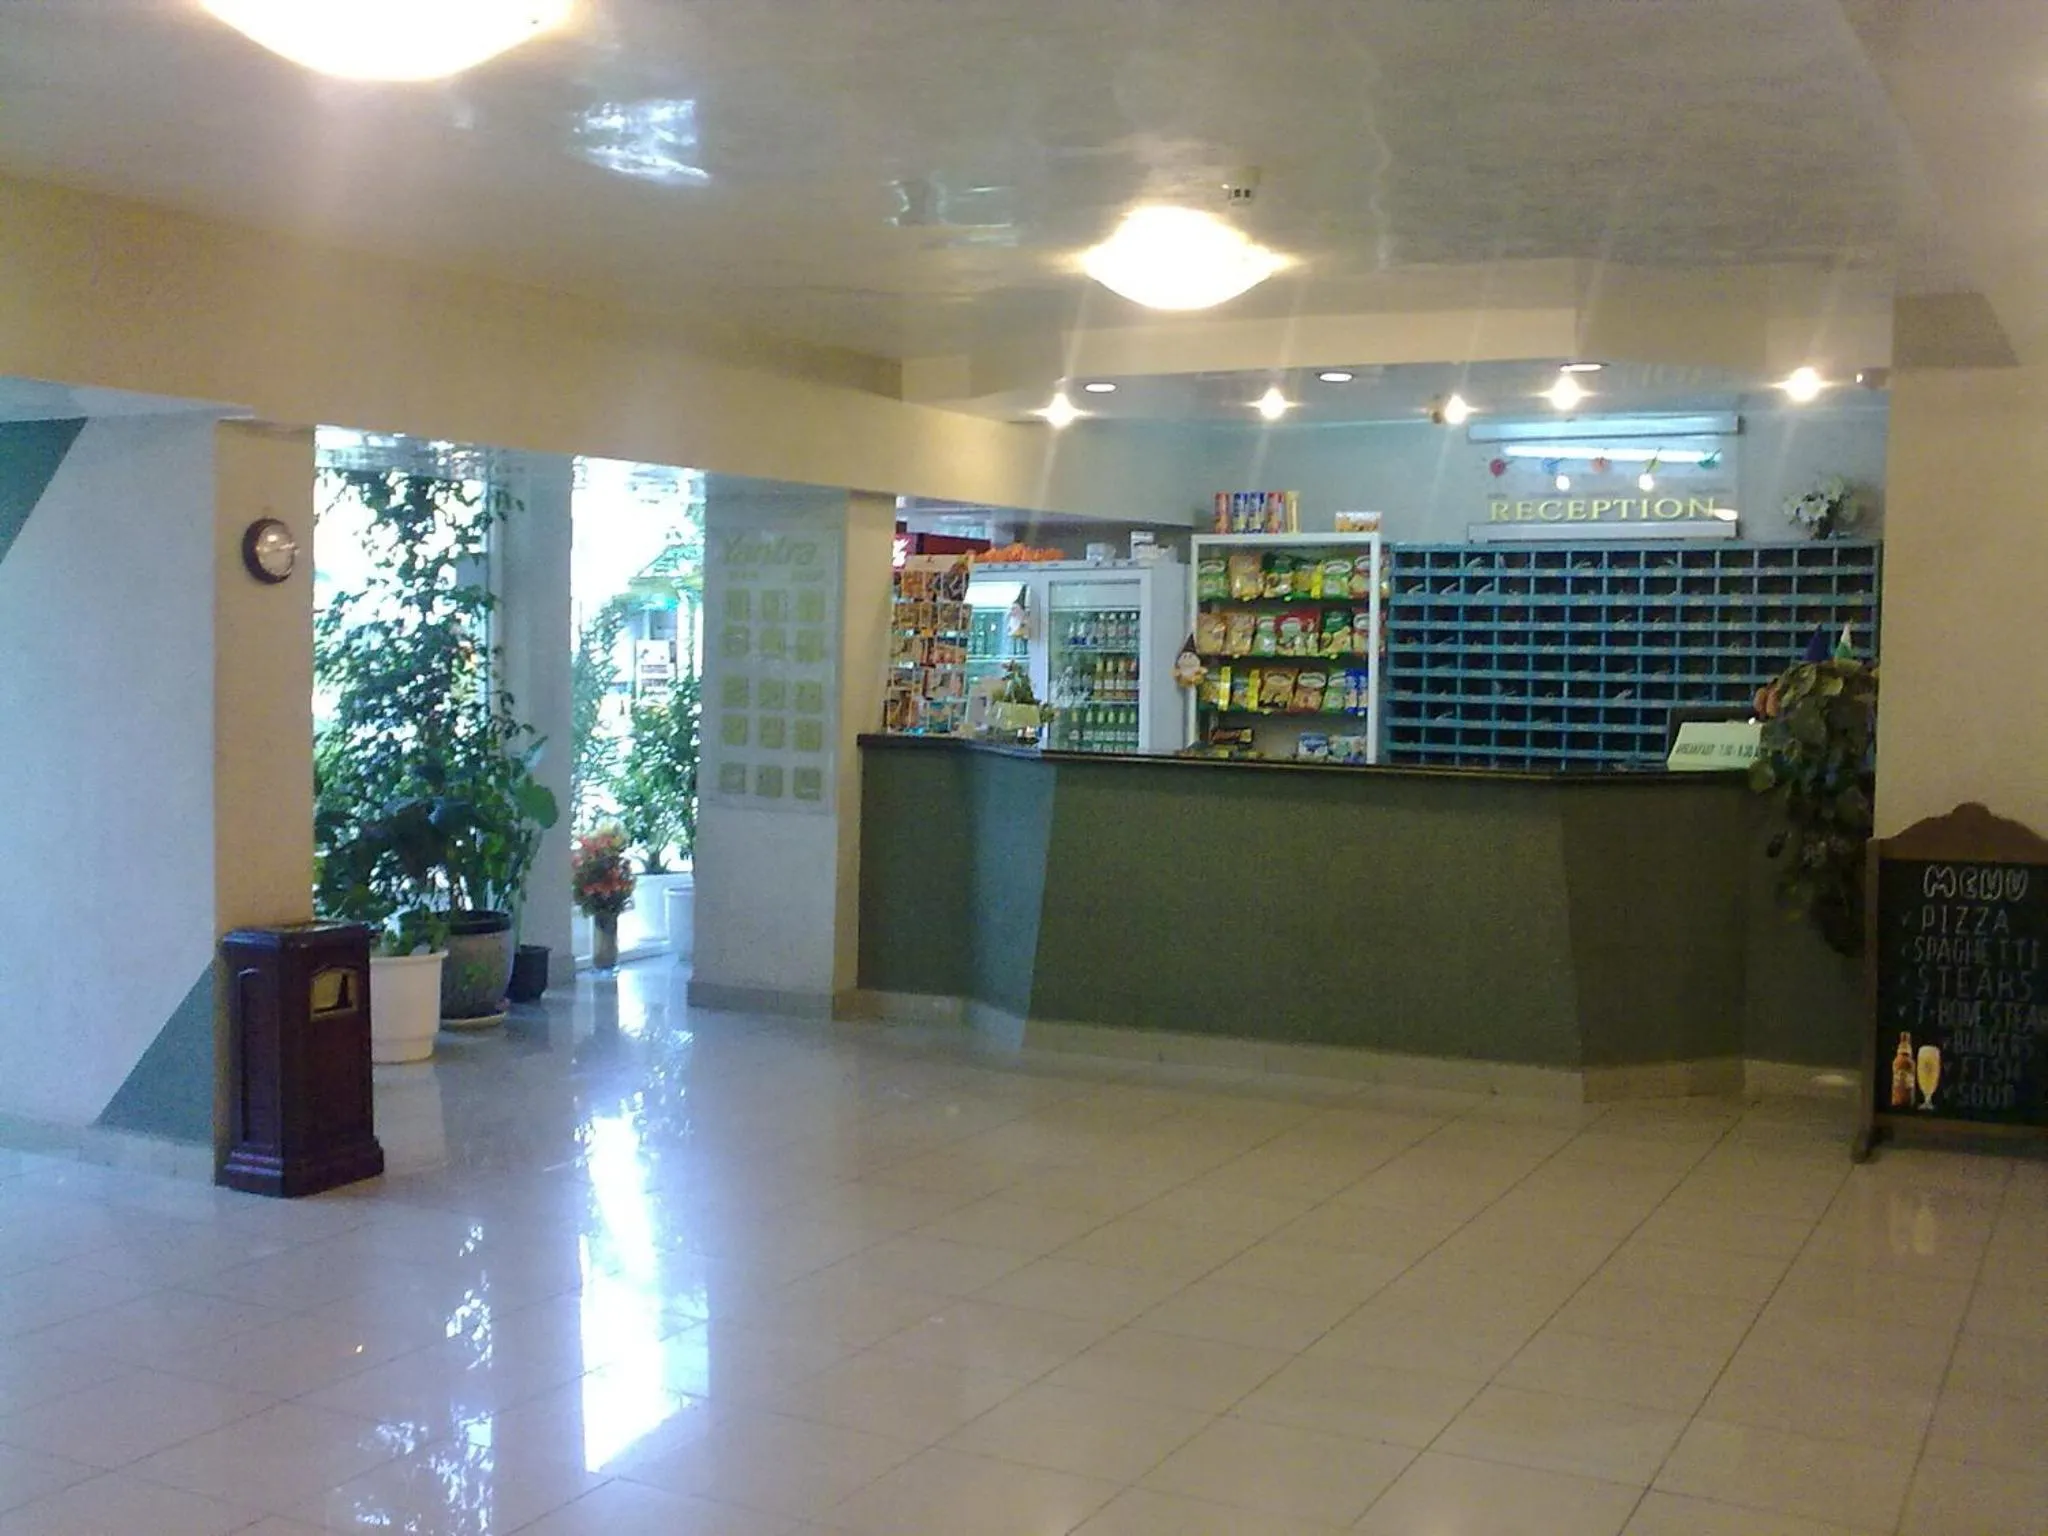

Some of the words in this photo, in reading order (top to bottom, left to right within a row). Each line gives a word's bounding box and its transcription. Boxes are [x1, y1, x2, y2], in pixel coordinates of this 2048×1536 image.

[1489, 496, 1717, 523] RECEPTION
[1922, 863, 2030, 902] MENU
[1921, 903, 2010, 935] PIZZA
